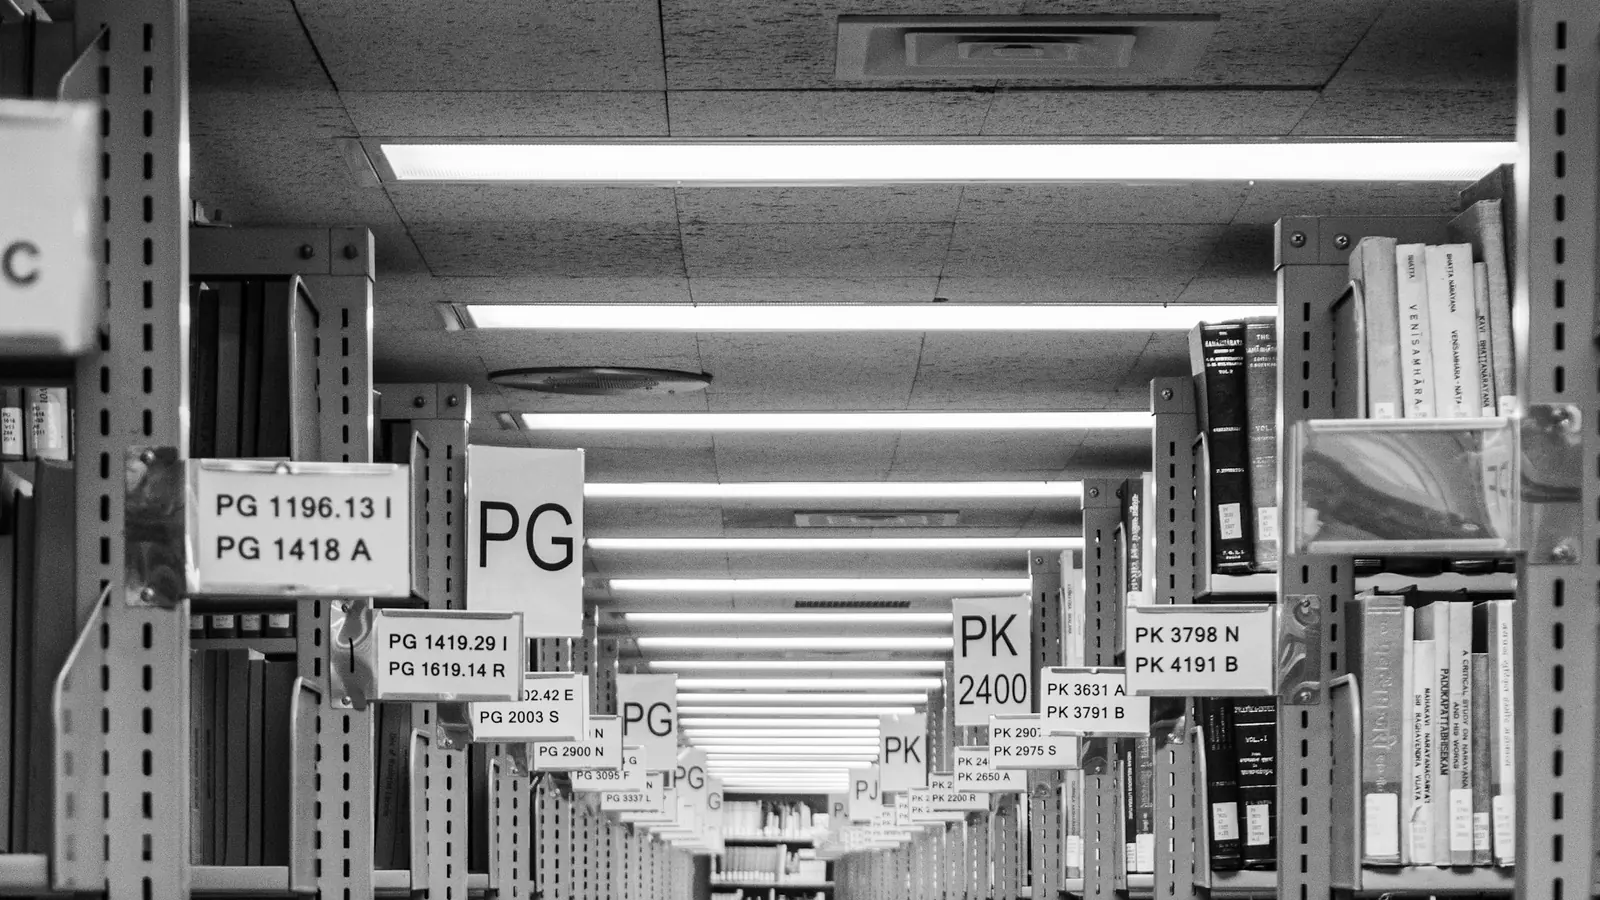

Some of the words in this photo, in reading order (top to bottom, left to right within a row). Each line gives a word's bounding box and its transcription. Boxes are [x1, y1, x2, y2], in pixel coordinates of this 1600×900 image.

[1, 239, 41, 287] C
[1478, 315, 1486, 335] KAVI
[216, 494, 258, 518] PG
[271, 494, 375, 519] 1196.13
[386, 496, 391, 519] I
[480, 501, 575, 572] PG
[216, 536, 260, 561] PG
[275, 536, 340, 561] 1418
[350, 538, 372, 561] A
[961, 614, 1018, 657] PK
[1136, 627, 1163, 643] PK
[1171, 626, 1218, 643] 3798
[1225, 626, 1239, 642] N
[389, 633, 418, 650] PG
[425, 633, 496, 651] 1419.29
[503, 635, 507, 652] I
[389, 660, 415, 677] PG
[421, 661, 488, 678] 1619.14
[494, 662, 506, 679] R
[1136, 657, 1164, 673] PK
[1170, 656, 1216, 673] 4191
[1225, 655, 1239, 672] B
[565, 689, 574, 701] E
[959, 672, 1027, 706] 2400
[1047, 683, 1069, 696] PK
[1074, 683, 1107, 696] 3631
[1114, 684, 1126, 696] A
[480, 711, 502, 724] PG
[508, 711, 544, 724] 2003
[549, 710, 559, 723] S
[624, 702, 672, 736] PG
[1047, 705, 1069, 718] PK
[1074, 706, 1107, 719] 3791
[1115, 706, 1125, 719] B
[595, 728, 604, 738] N
[994, 728, 1011, 738] PK
[1462, 728, 1468, 741] ON
[539, 746, 558, 757] PG
[562, 746, 591, 757] 2900
[595, 746, 604, 757] N
[885, 735, 921, 764] PK
[994, 746, 1011, 756] PK
[1016, 746, 1044, 756] 2975
[1048, 745, 1057, 756] S
[629, 756, 637, 765] G
[958, 757, 973, 766] PK
[576, 771, 592, 780] PG
[596, 770, 620, 780] 3095
[623, 770, 630, 780] F
[673, 766, 704, 790] PG
[958, 772, 973, 781] PK
[976, 772, 1000, 781] 2650
[1003, 772, 1011, 781] A
[646, 781, 653, 789] N
[855, 780, 878, 801] PJ
[932, 781, 945, 789] PK
[606, 794, 620, 802] PG
[623, 794, 643, 802] 3337
[646, 794, 651, 802] L
[708, 792, 721, 810] G
[932, 794, 945, 802] PK
[947, 794, 967, 802] 2200
[969, 794, 976, 802] R
